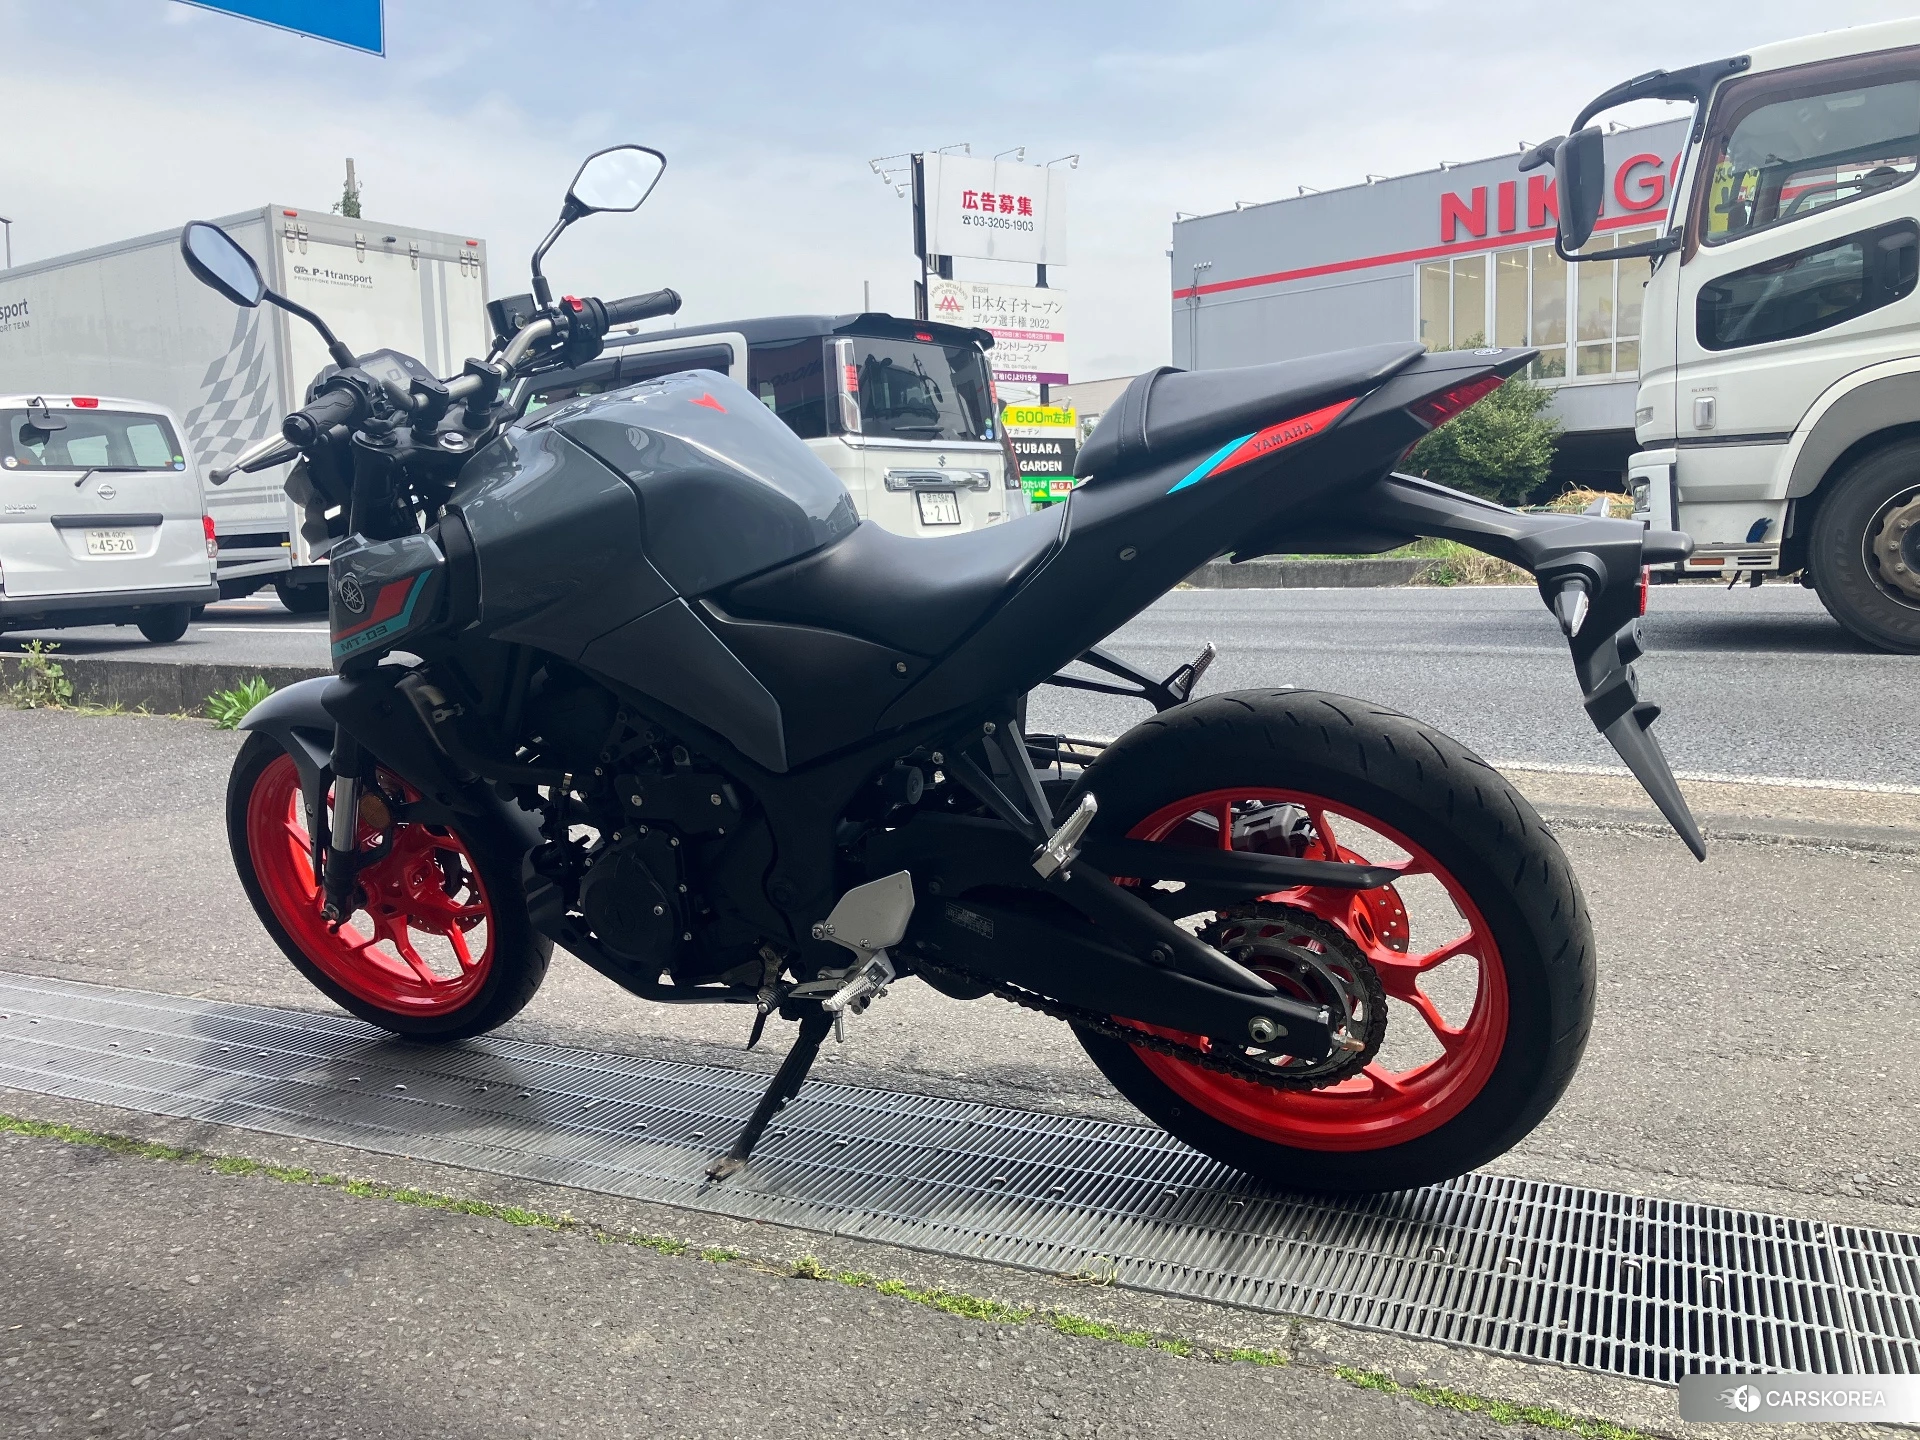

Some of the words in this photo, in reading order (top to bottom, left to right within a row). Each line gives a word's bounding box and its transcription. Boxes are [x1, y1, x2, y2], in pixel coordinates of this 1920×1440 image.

[962, 190, 1033, 217] 広告募集
[973, 215, 1034, 232] 03-3205-1903
[972, 295, 1063, 314] 日本女子オープン
[13, 320, 31, 330] TEAM
[973, 313, 1028, 328] ゴルフ選手権
[1030, 318, 1050, 329] 2022
[1016, 411, 1072, 424] 600m左折
[1253, 422, 1313, 452] YAMAHA
[1020, 460, 1062, 472] GARDEN
[99, 539, 134, 551] 45-20
[340, 625, 388, 652] MT-03
